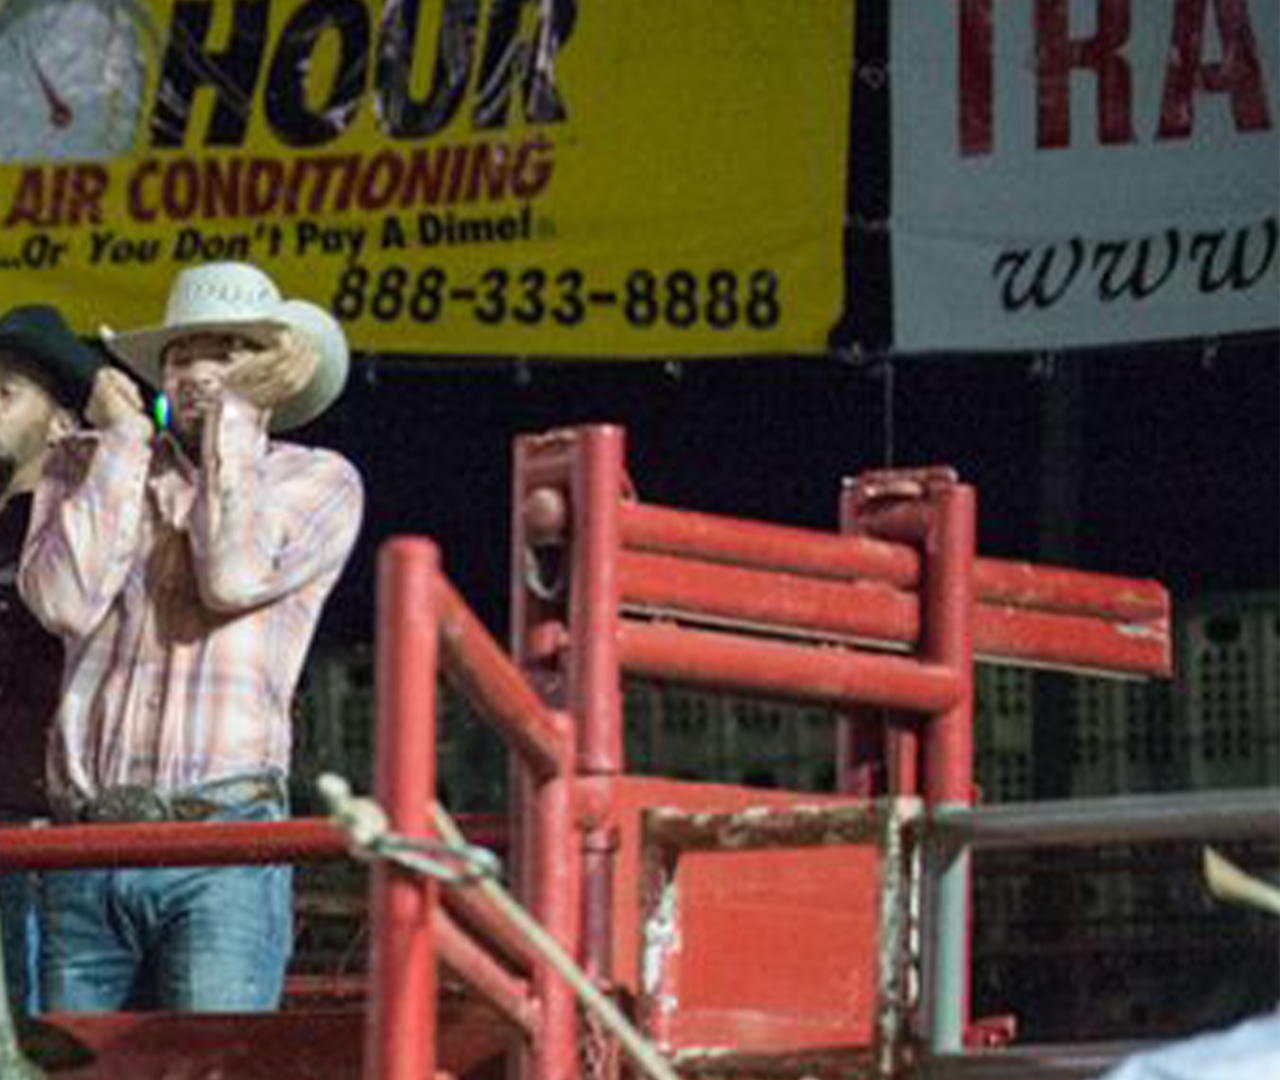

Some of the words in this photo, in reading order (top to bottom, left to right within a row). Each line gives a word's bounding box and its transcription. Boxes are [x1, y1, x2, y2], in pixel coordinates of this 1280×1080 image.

[149, 0, 577, 148] HOUR
[4, 164, 109, 228] AIR
[126, 142, 556, 222] CONDITIONING
[90, 231, 161, 262] You
[173, 222, 283, 261] Don't
[296, 219, 366, 261] Pay
[381, 215, 406, 249] A
[417, 206, 532, 246] Dime!
[333, 267, 781, 331] 888-333-8888
